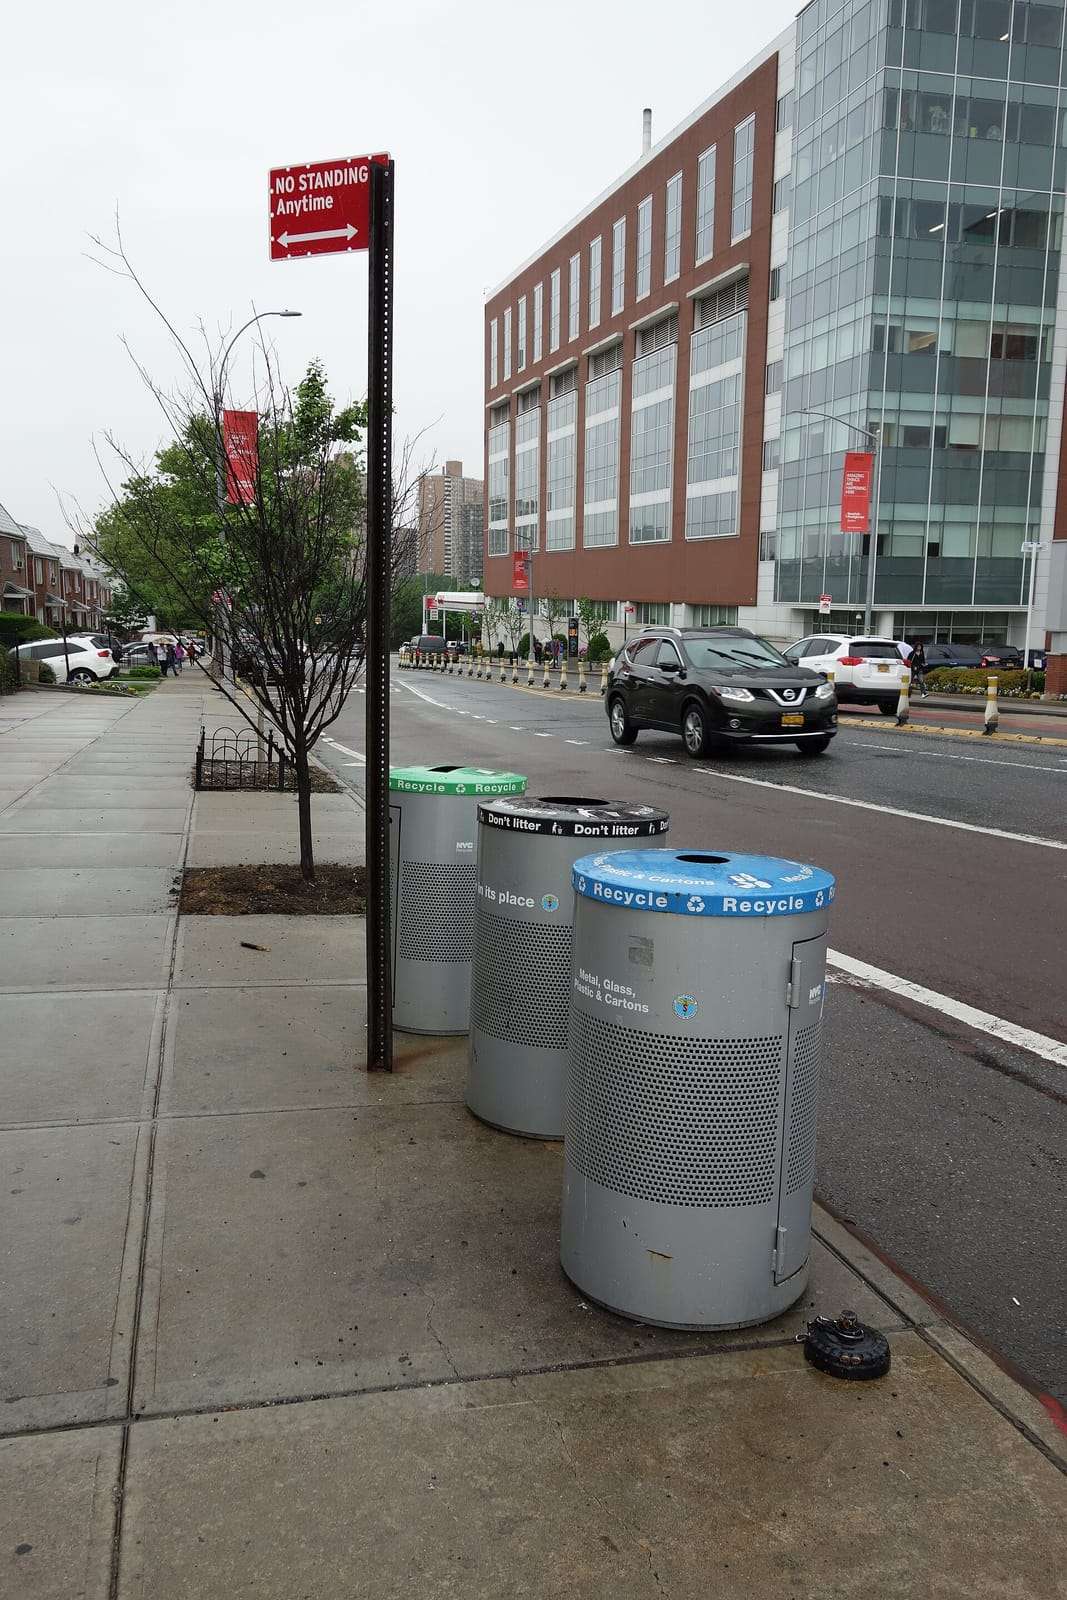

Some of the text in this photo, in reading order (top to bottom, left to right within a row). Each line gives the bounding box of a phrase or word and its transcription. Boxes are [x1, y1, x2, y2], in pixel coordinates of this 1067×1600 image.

[276, 165, 369, 195] NO STANDING
[276, 194, 334, 217] Anytime
[397, 780, 445, 792] Recycle
[475, 782, 516, 792] Recycle
[488, 813, 542, 831] Don't litter
[574, 824, 639, 836] Don't litter
[648, 876, 715, 886] Cartons
[485, 885, 496, 900] its
[498, 891, 535, 908] place
[593, 883, 668, 908] Recycle
[723, 897, 804, 914] Recycle
[579, 968, 636, 998] Metal, Glass,
[574, 978, 649, 1013] Plastic & Cartons
